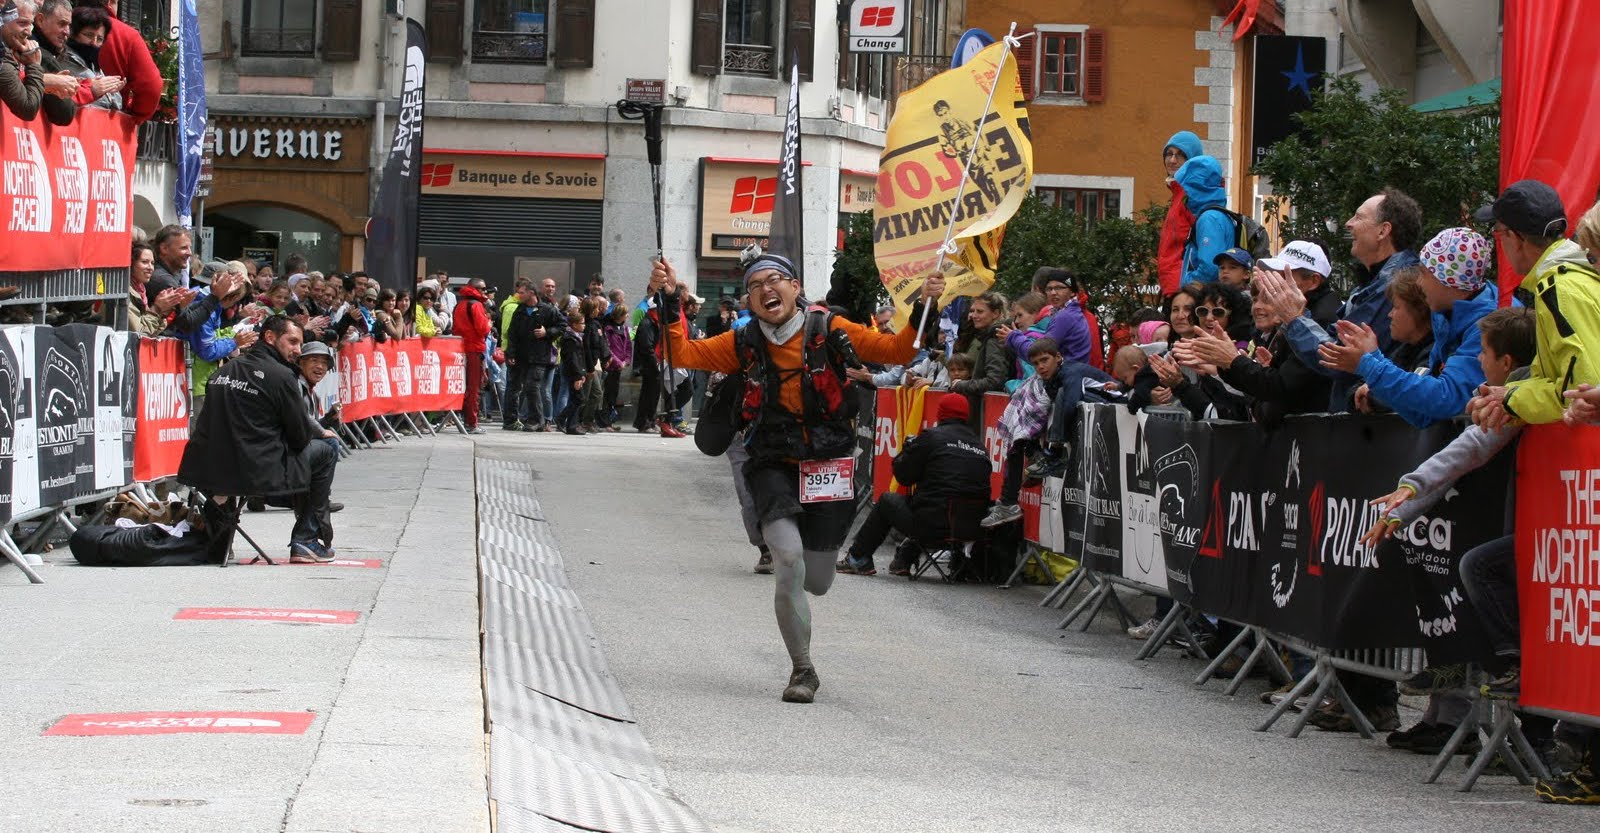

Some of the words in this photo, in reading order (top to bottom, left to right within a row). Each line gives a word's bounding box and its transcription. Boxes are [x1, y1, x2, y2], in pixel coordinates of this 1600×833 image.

[857, 38, 897, 50] Change
[13, 126, 34, 162] THE
[61, 136, 78, 167] THE
[101, 139, 116, 170] THE
[212, 127, 342, 161] AVERNE
[4, 163, 37, 197] NORTH
[55, 168, 82, 200] NORTH
[90, 170, 117, 201] NORTH
[458, 169, 517, 188] Banque
[521, 170, 540, 185] de
[545, 172, 597, 187] Savoie
[12, 200, 37, 232] FACE
[64, 201, 83, 233] FACE
[95, 202, 116, 232] FACE
[732, 217, 772, 232] Change
[415, 365, 433, 380] NORTH
[422, 350, 433, 365] THE
[417, 380, 433, 395] FACE
[807, 473, 838, 486] 3957
[1560, 469, 1600, 525] THE
[1532, 528, 1600, 585] NORTH
[1549, 587, 1600, 646] FACE
